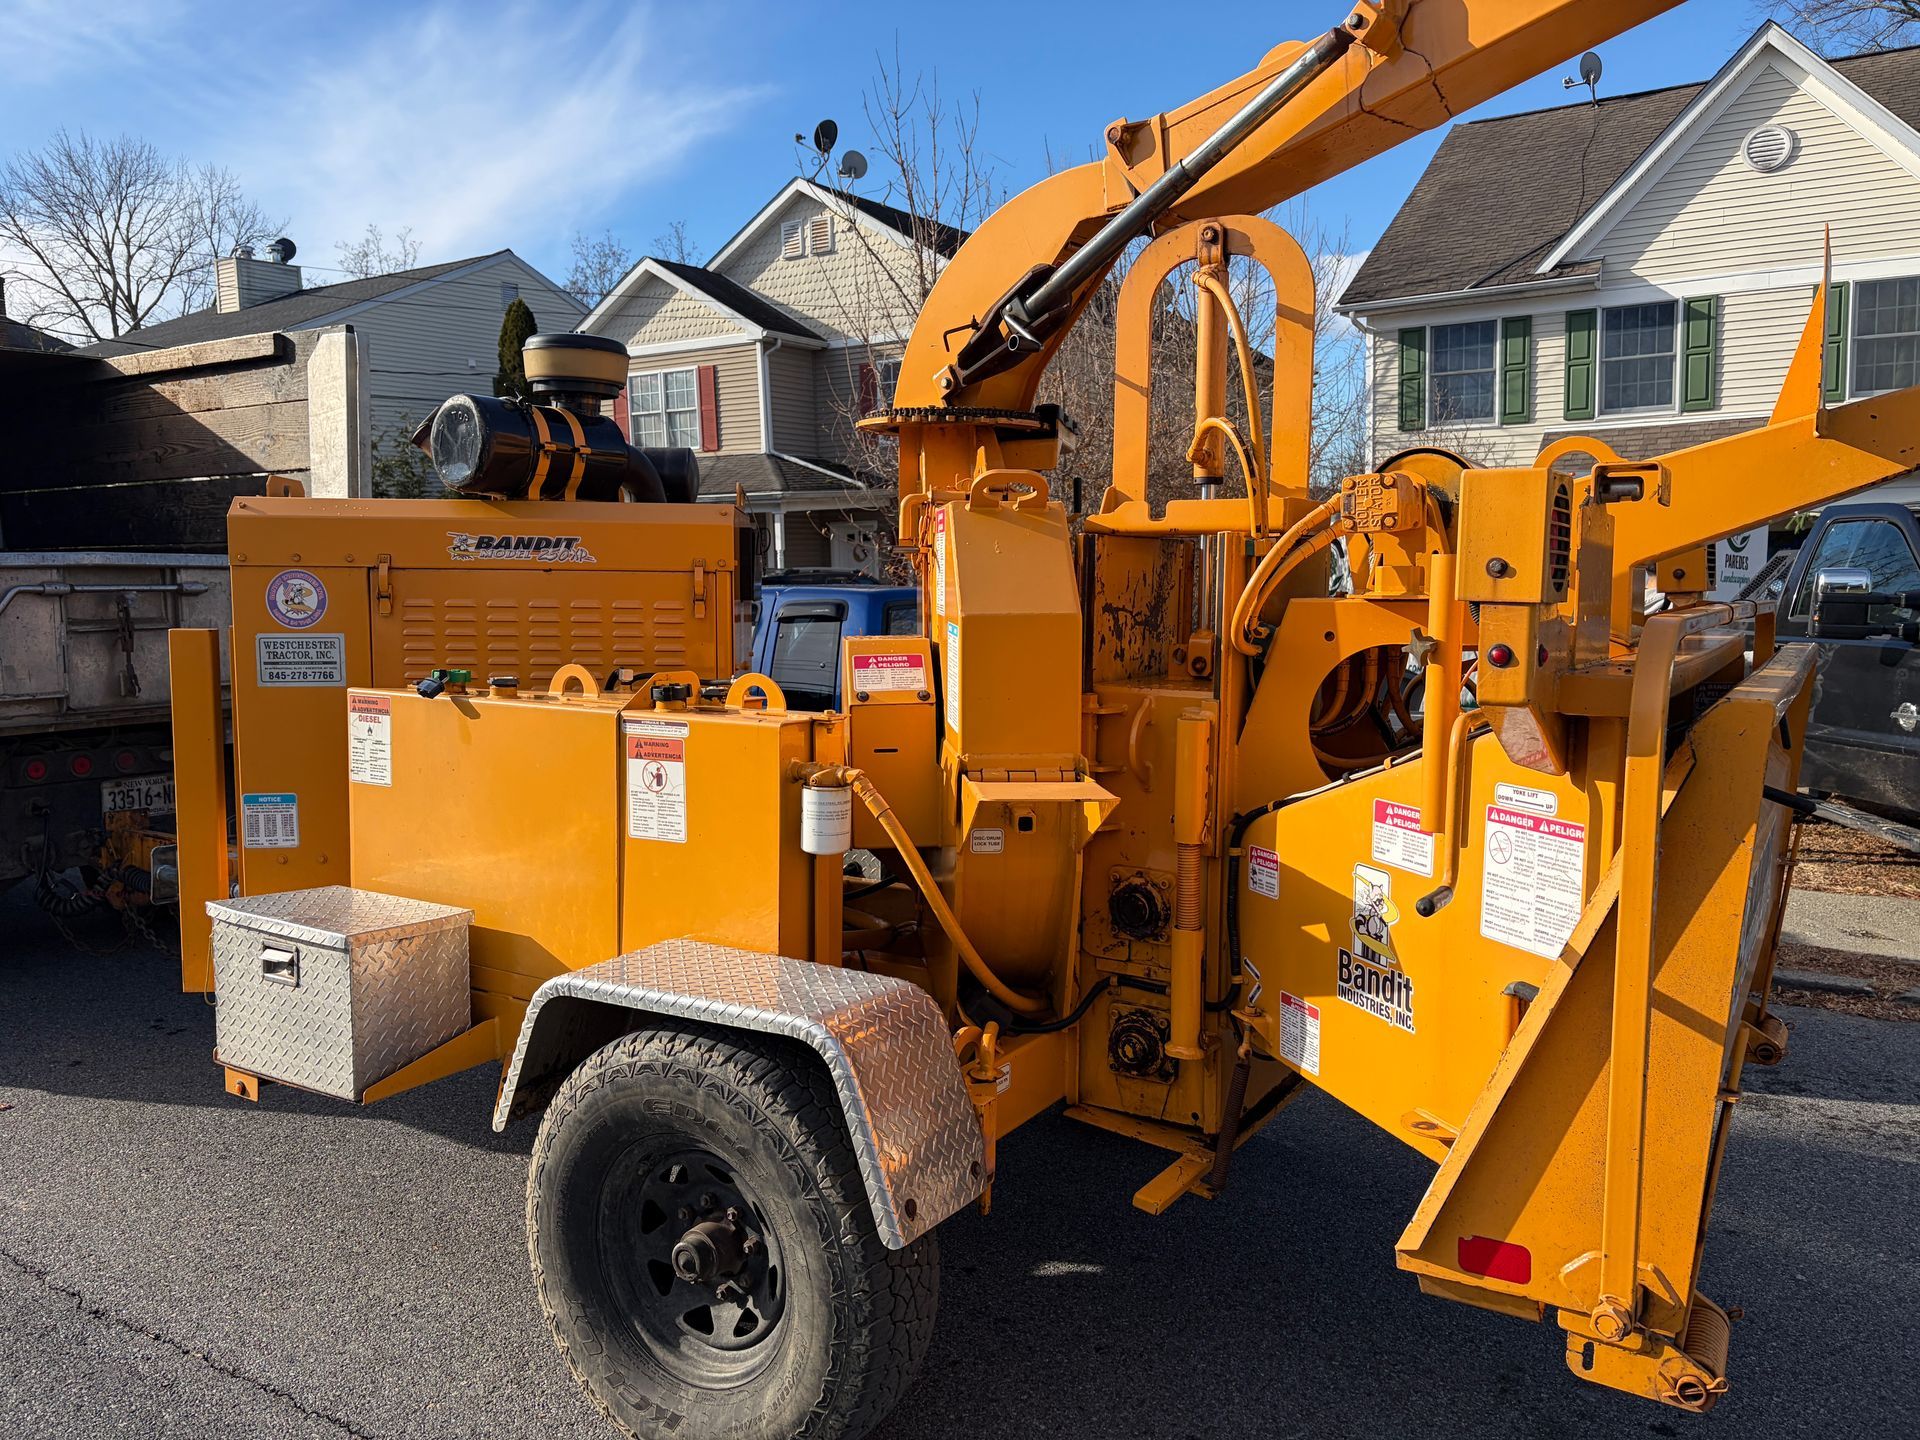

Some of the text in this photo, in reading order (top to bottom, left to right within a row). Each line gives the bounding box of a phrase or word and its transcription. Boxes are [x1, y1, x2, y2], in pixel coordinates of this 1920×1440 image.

[451, 411, 469, 422] TOP
[474, 535, 581, 550] BANDIT
[480, 549, 531, 559] MODEL
[1725, 554, 1749, 570] PAREDES
[264, 641, 336, 650] WESTCHESTER
[266, 651, 334, 660] TRACTOR, INC.
[269, 671, 334, 681] 845-278-7766
[358, 706, 389, 714] ADVERTENCIA
[359, 714, 382, 724] DIESEL
[643, 741, 669, 750] WARNING
[643, 751, 682, 762] ADVERTENCIA
[124, 778, 165, 790] NEW YORK
[109, 784, 175, 811] 33516-N
[1498, 794, 1513, 802] DOWN
[1513, 789, 1527, 797] YOKE
[1393, 806, 1420, 819] DANGER
[1393, 817, 1421, 831] PELIGRO
[1499, 813, 1535, 828] DANGER
[1257, 849, 1277, 860] DANGER
[1257, 857, 1278, 870] PELIGRO
[1339, 948, 1413, 1014] Bandit
[1338, 983, 1415, 1031] INDUSTRIES, INC.
[642, 1097, 768, 1179] EDGE
